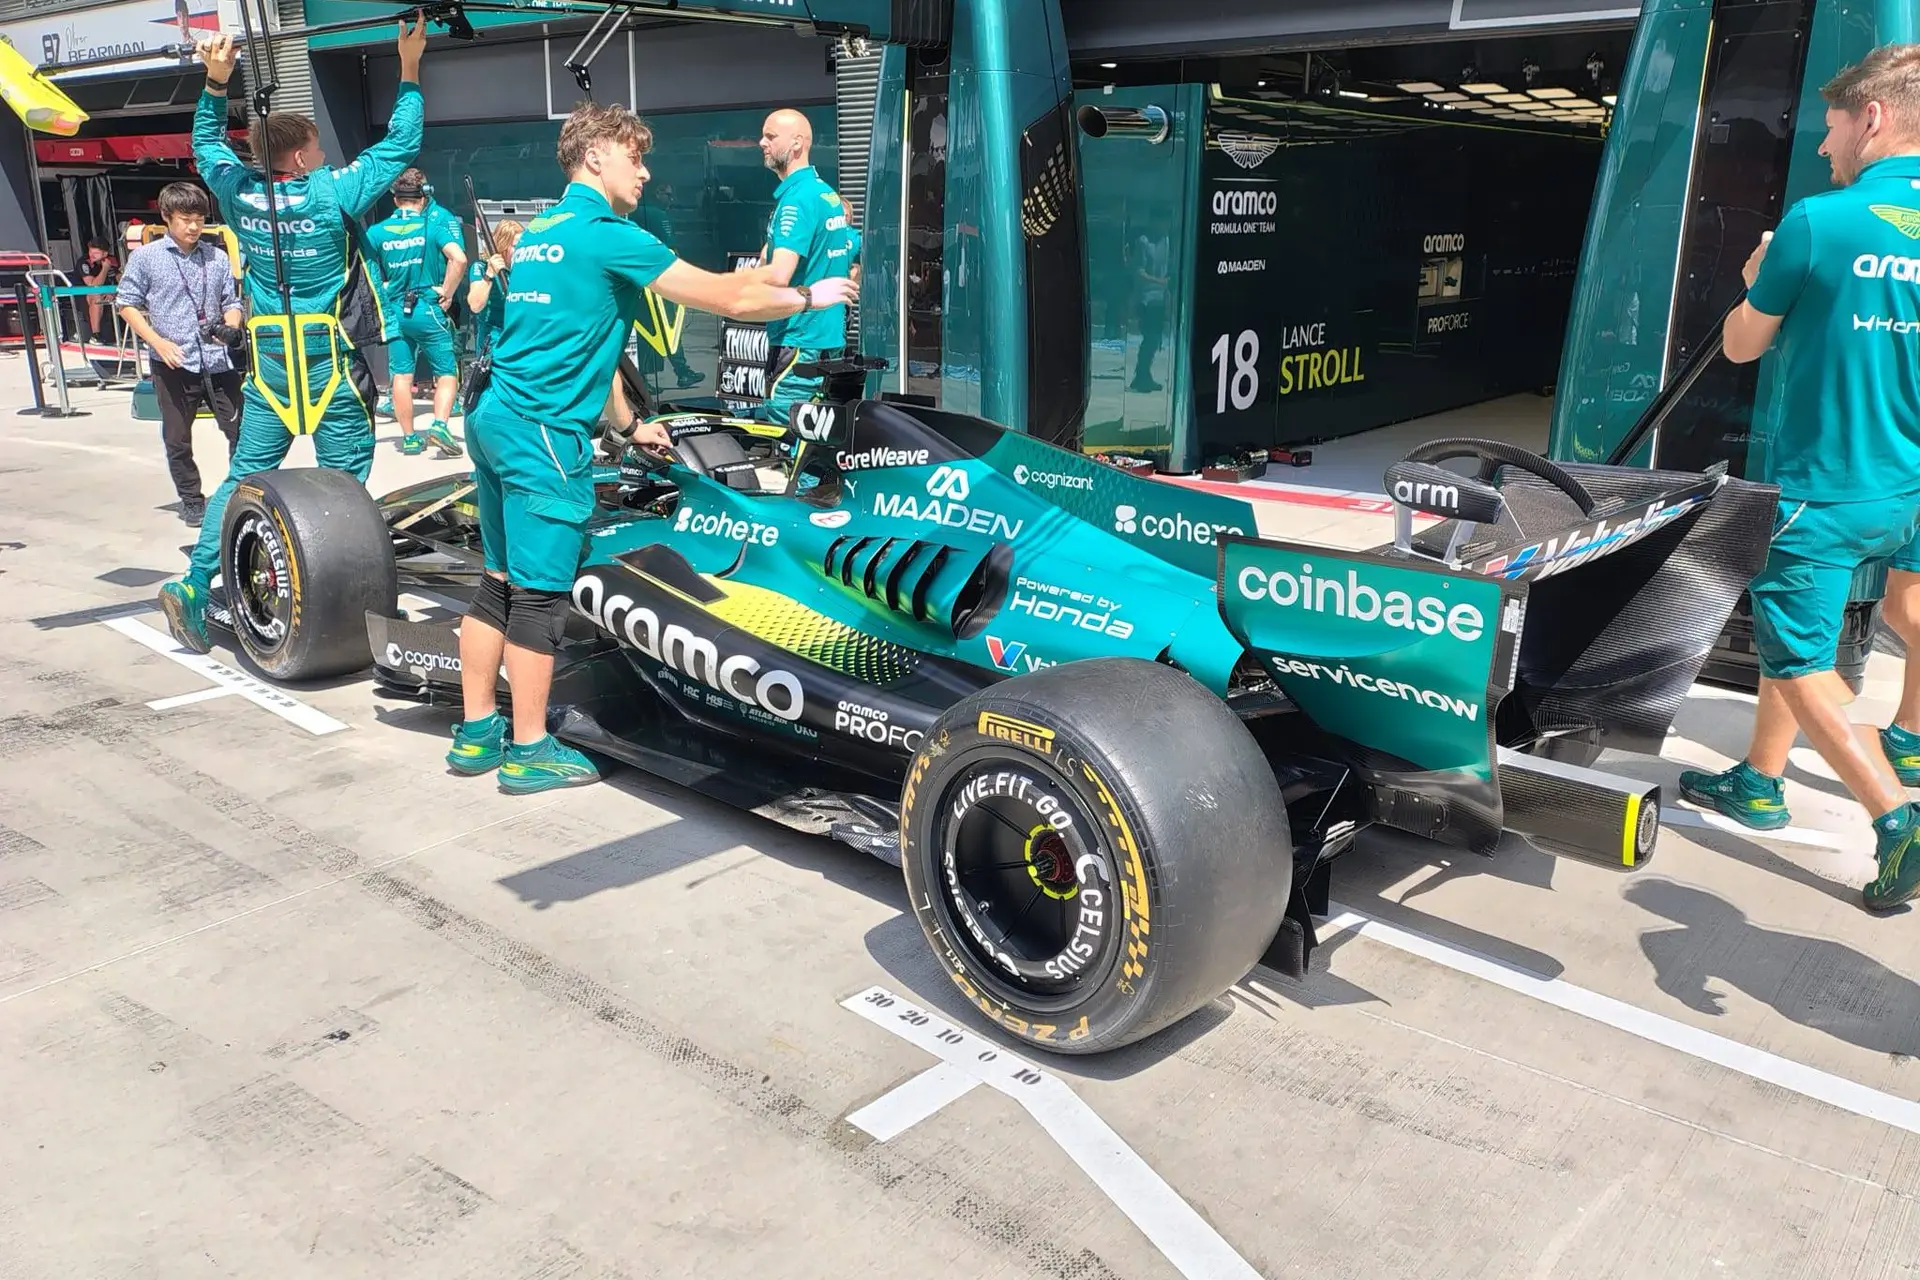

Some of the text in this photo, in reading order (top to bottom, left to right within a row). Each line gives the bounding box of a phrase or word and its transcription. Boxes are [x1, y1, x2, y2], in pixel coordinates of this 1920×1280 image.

[1212, 190, 1277, 215] aramco
[1211, 222, 1242, 234] FORMULA
[1259, 221, 1276, 233] TEAM
[382, 236, 426, 251] aramco
[511, 243, 565, 264] amco
[1423, 233, 1465, 254] aramco
[1228, 259, 1266, 273] MAADEN
[1282, 322, 1326, 349] LANCE
[1427, 312, 1470, 334] PROFORCE
[734, 366, 748, 395] OF
[1211, 329, 1260, 414] 18
[1280, 347, 1365, 395] STROLL
[836, 446, 929, 471] CoreWeave
[1031, 469, 1094, 491] cognizant
[1394, 479, 1459, 509] arm
[690, 511, 779, 547] cohere
[873, 492, 1024, 540] MAADEN
[263, 531, 289, 599] CELSIUS
[1016, 576, 1122, 612] Powered by
[1238, 563, 1484, 642] coinbase
[1009, 591, 1134, 640] Honda
[571, 574, 805, 722] aramco
[683, 683, 700, 698] HRC
[706, 693, 723, 707] HRS
[1272, 656, 1478, 722] servicenow
[749, 708, 773, 720] ATLAS
[837, 700, 889, 721] aramco
[978, 711, 1056, 754] PIRELLI
[1045, 888, 1103, 979] CELSIUS
[865, 992, 1041, 1085] 30 20 10 0 10
[1068, 1016, 1090, 1041] P
